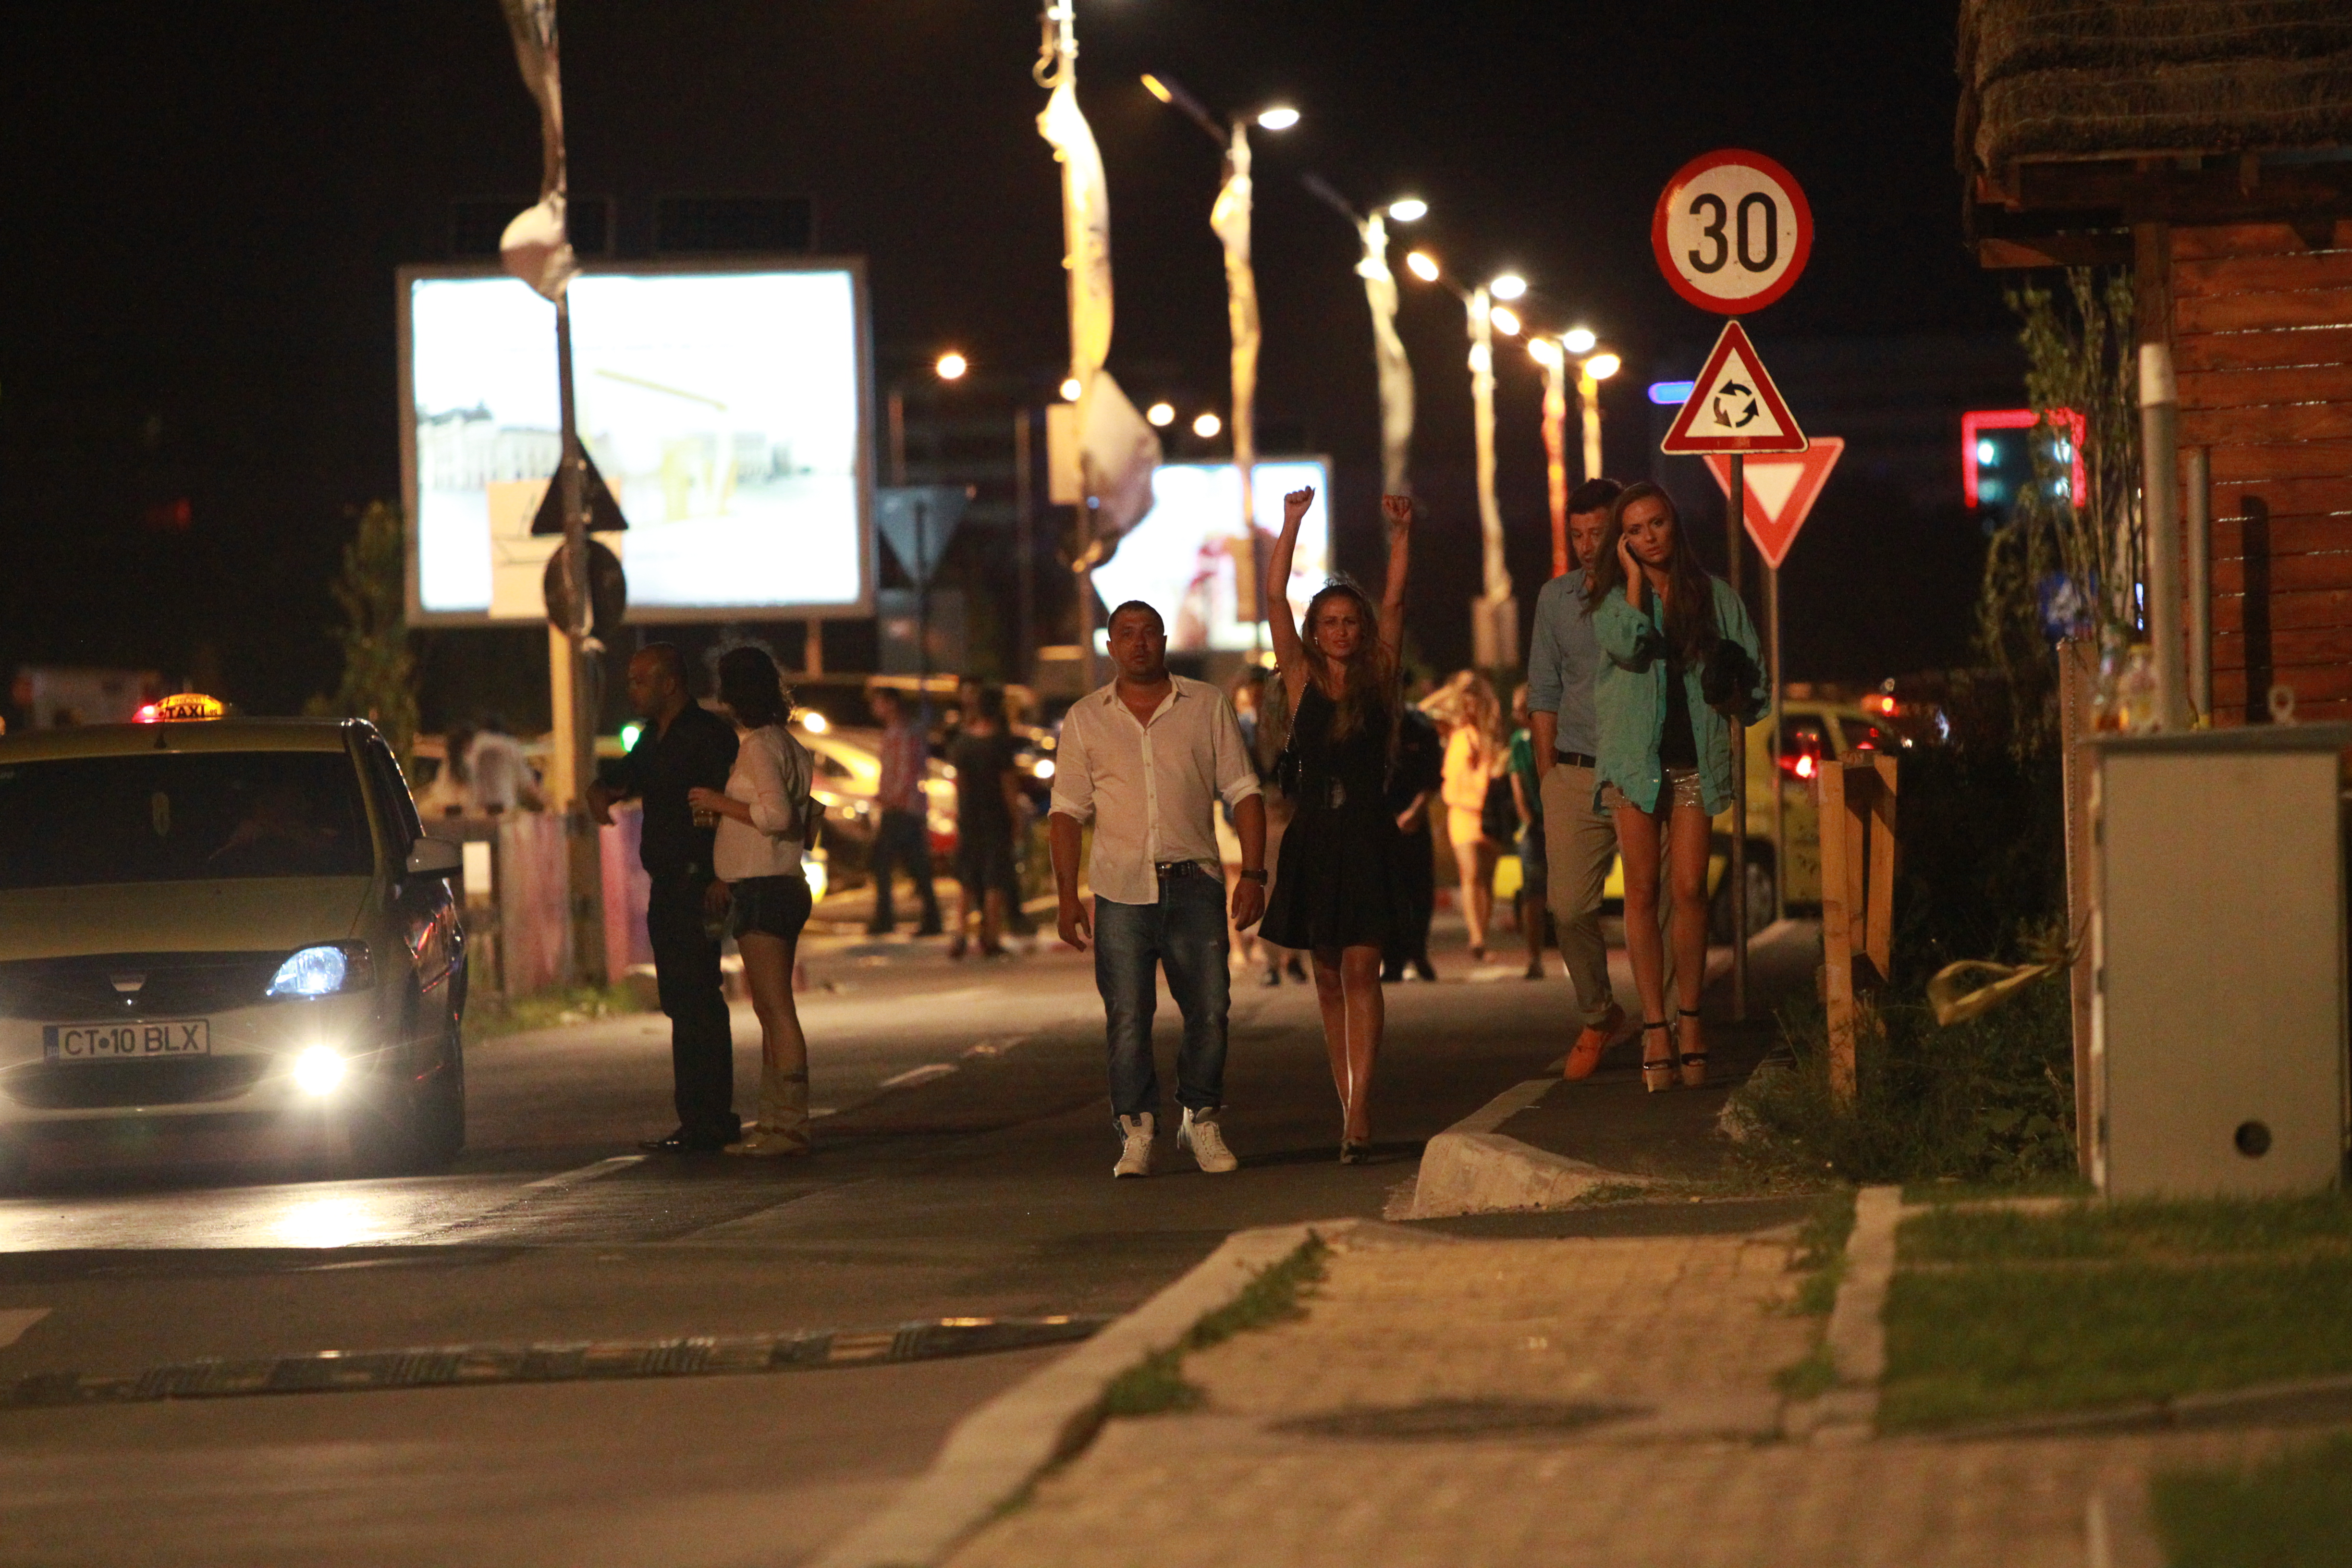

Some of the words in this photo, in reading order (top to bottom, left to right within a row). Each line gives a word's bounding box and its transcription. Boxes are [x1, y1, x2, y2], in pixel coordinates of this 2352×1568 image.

[1689, 192, 1777, 273] 30
[167, 705, 205, 719] TAXI
[145, 1025, 198, 1052] BLX
